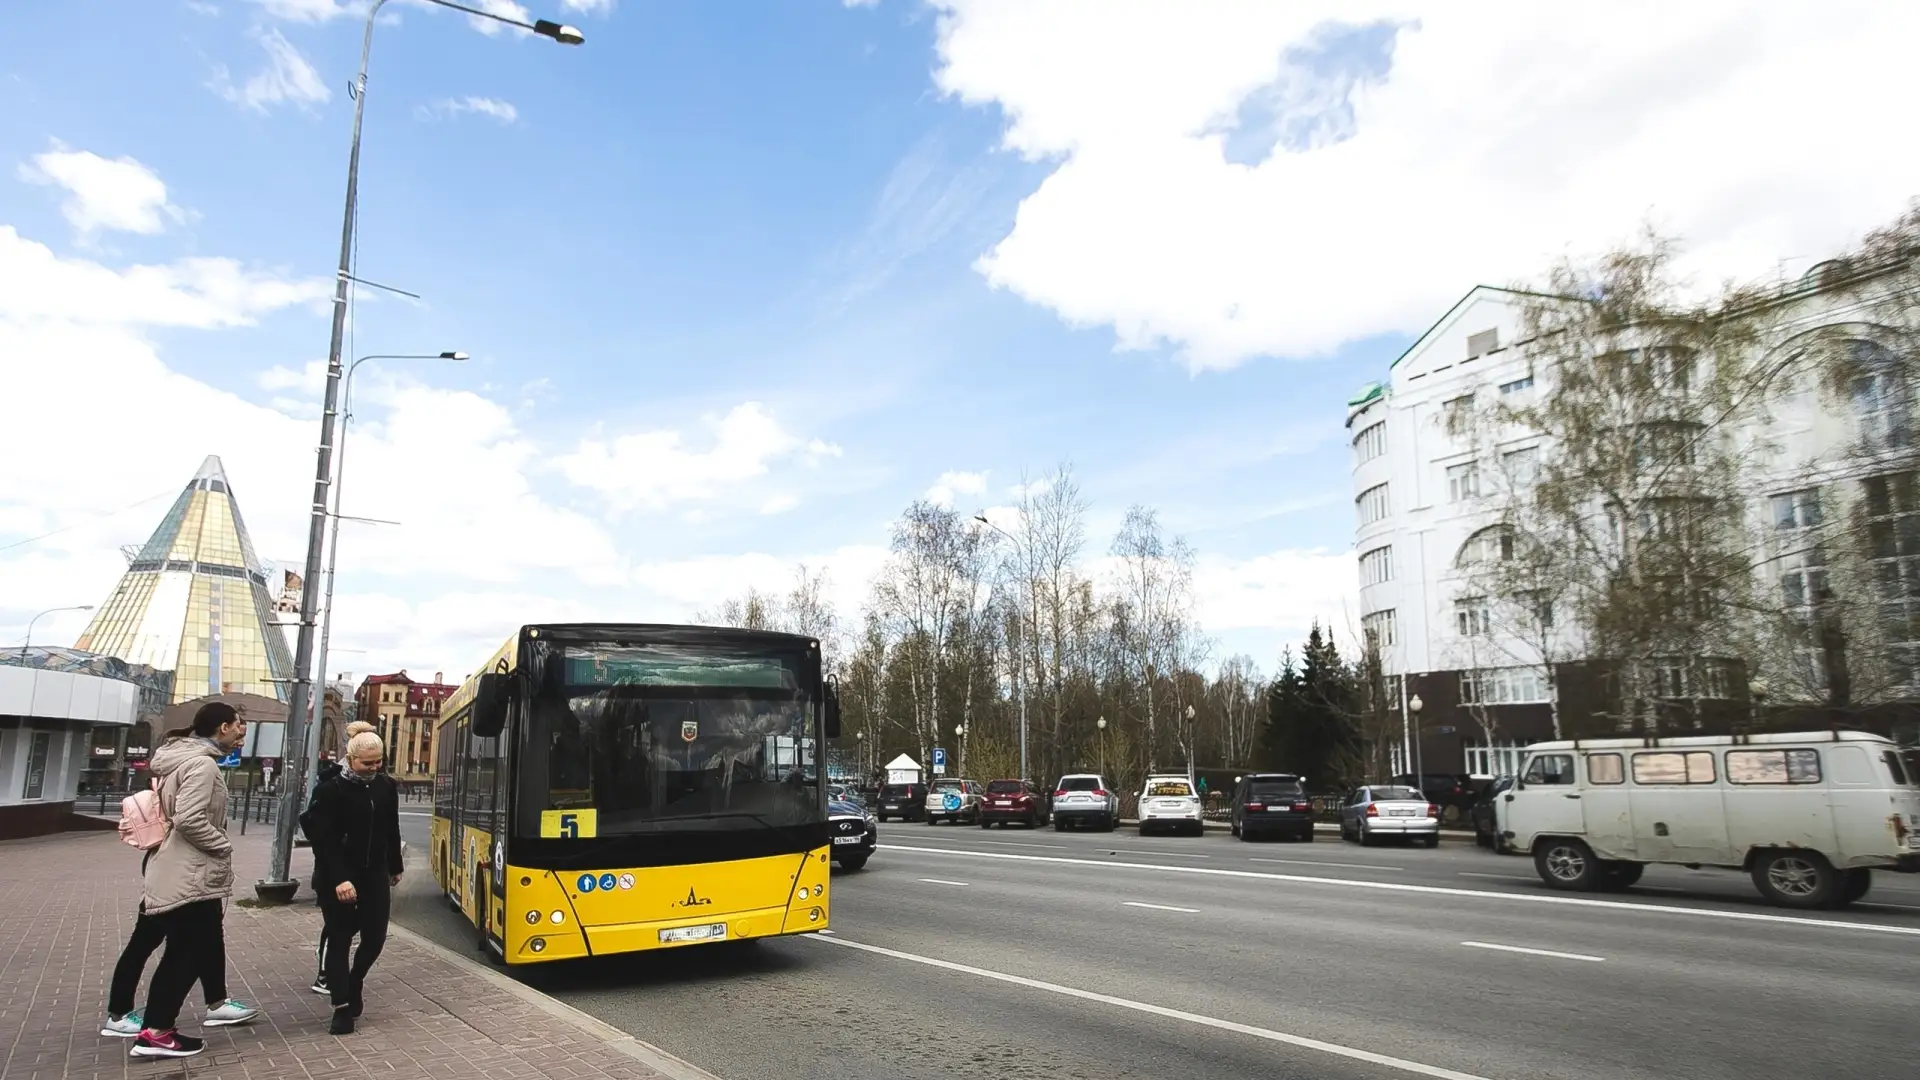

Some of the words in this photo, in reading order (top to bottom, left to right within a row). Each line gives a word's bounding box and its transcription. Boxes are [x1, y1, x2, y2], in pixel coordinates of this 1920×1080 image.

[594, 652, 608, 682] 5
[935, 750, 943, 763] P
[560, 813, 579, 839] 5
